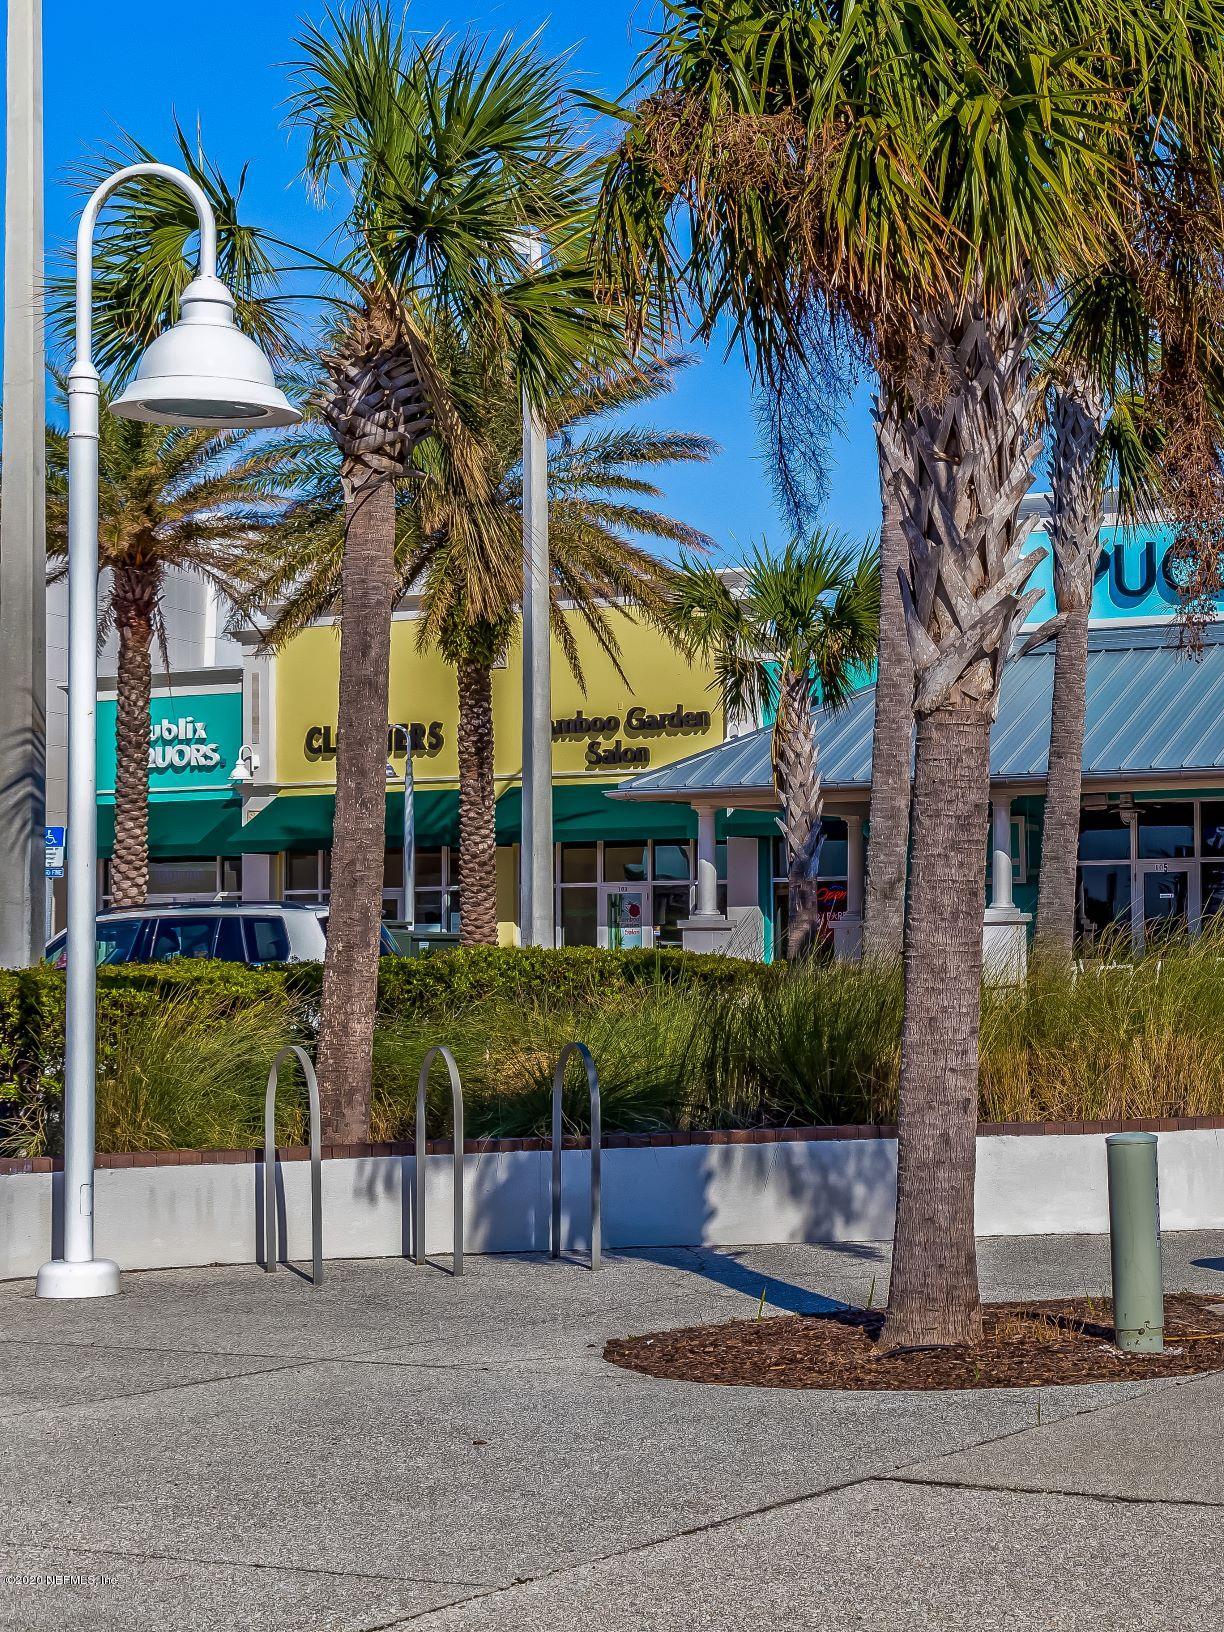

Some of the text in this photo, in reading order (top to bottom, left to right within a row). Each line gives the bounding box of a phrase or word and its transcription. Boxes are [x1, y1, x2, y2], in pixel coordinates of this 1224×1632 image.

[149, 717, 207, 741] ublix
[626, 704, 710, 731] Garden
[305, 721, 445, 755] CLERS
[587, 740, 650, 765] Salon
